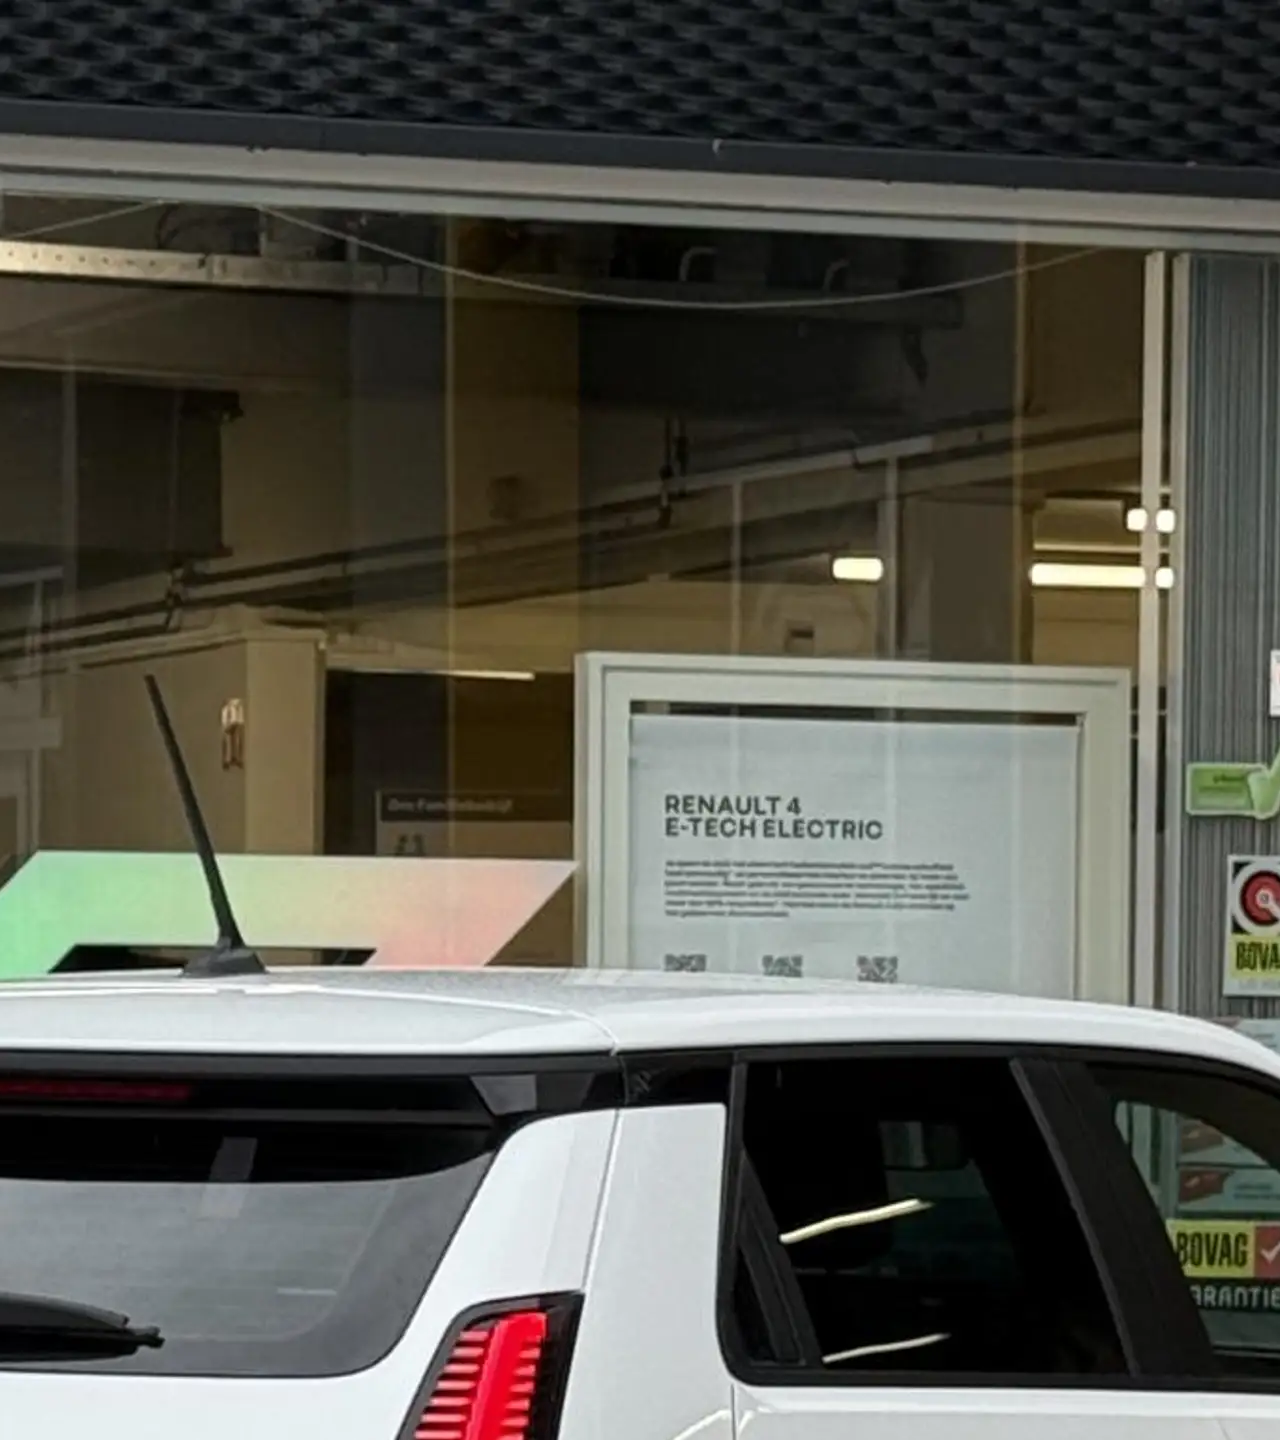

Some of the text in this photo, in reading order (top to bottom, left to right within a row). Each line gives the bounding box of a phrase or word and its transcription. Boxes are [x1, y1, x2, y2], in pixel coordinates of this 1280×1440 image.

[665, 794, 802, 816] RENAULT 4
[665, 817, 883, 840] E-TECH ELECTRIC
[1176, 1231, 1249, 1268] BOVAG
